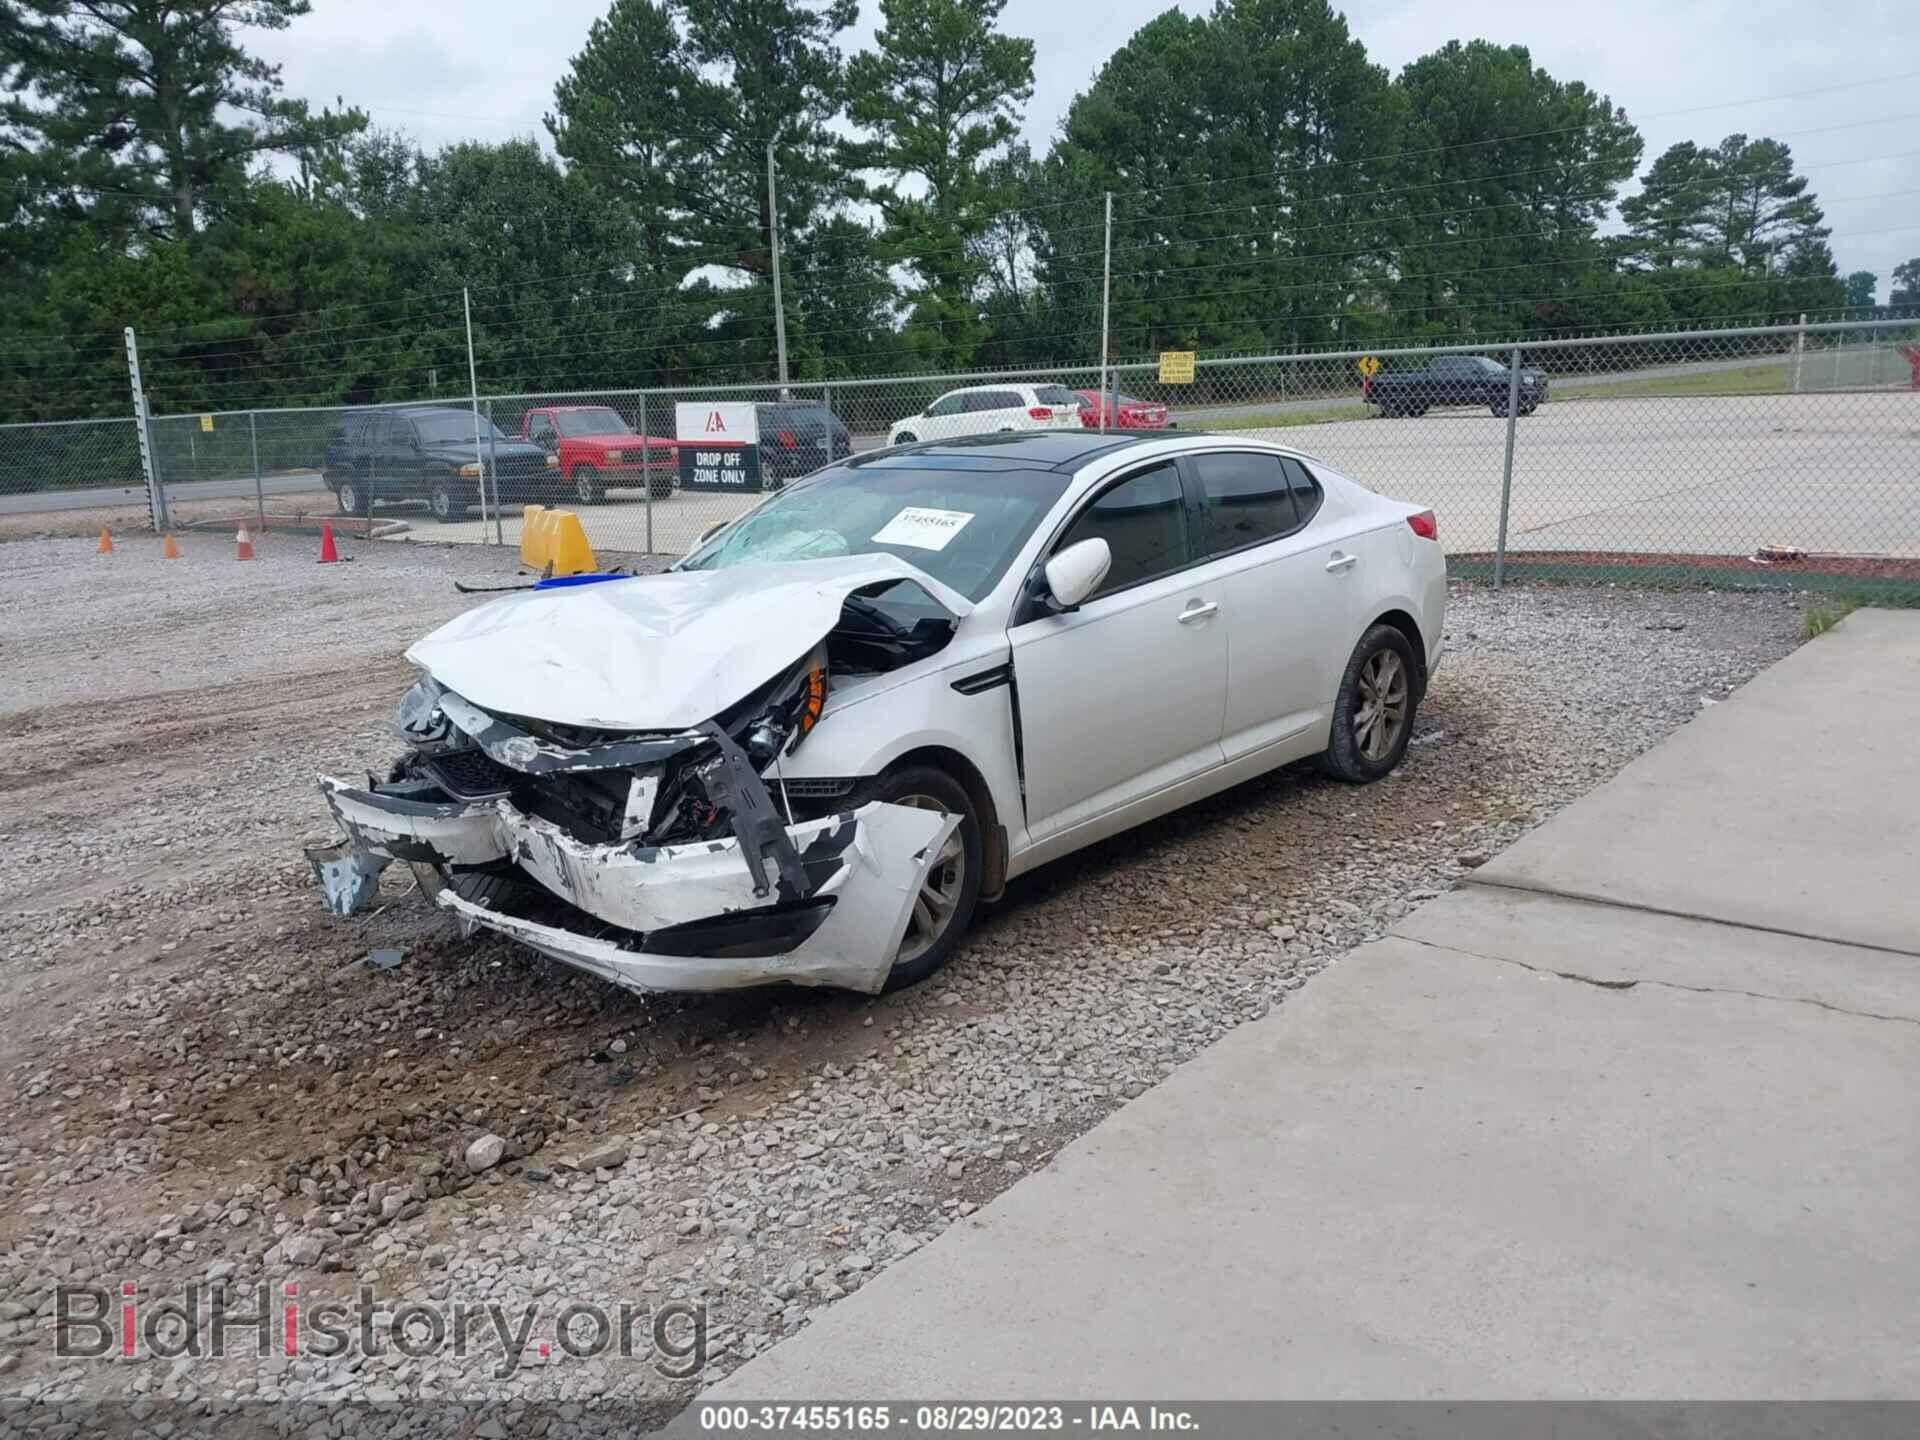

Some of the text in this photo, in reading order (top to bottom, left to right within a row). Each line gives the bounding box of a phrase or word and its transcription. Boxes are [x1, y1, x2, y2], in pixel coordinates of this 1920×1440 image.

[696, 452, 742, 466] DROP OFF
[693, 468, 746, 484] ZONE ONLY
